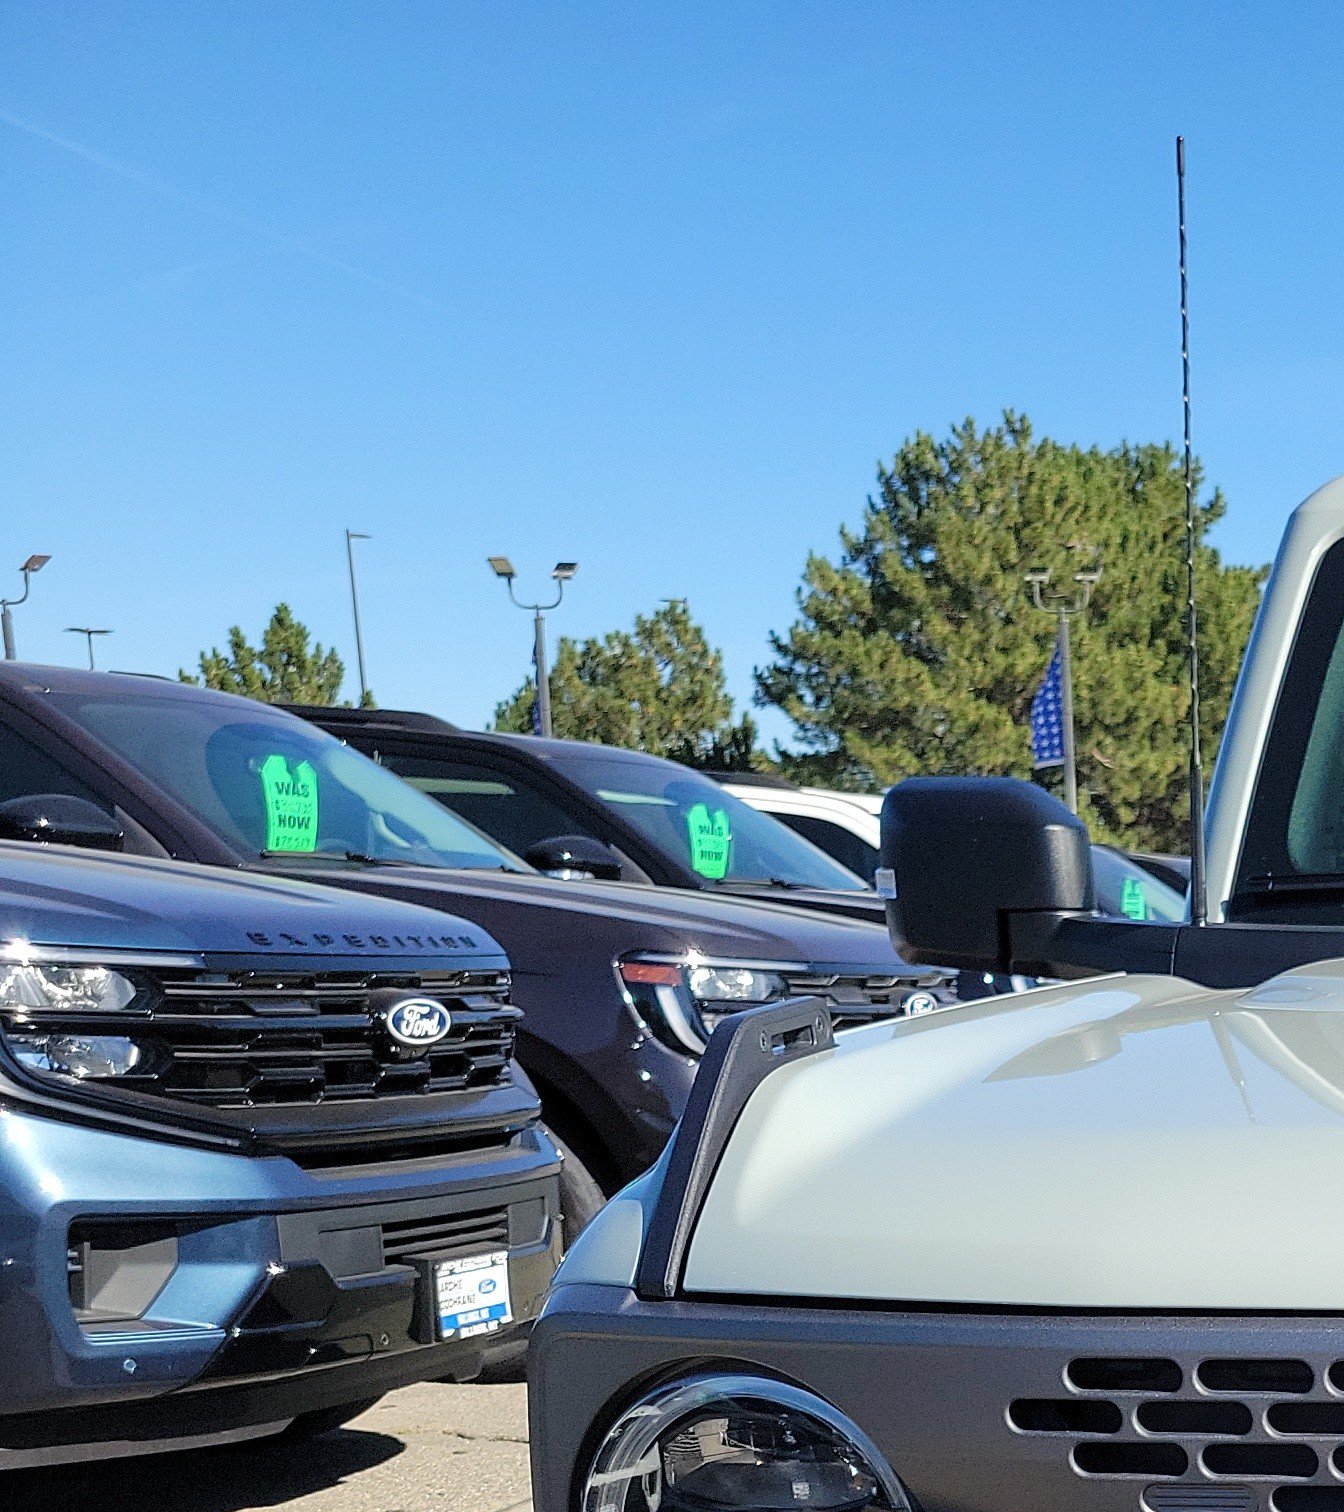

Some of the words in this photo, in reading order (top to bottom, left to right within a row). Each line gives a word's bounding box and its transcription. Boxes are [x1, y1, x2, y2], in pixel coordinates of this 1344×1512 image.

[277, 814, 312, 831] NOW
[246, 931, 478, 949] EXPEDITION
[401, 1005, 441, 1037] Ford
